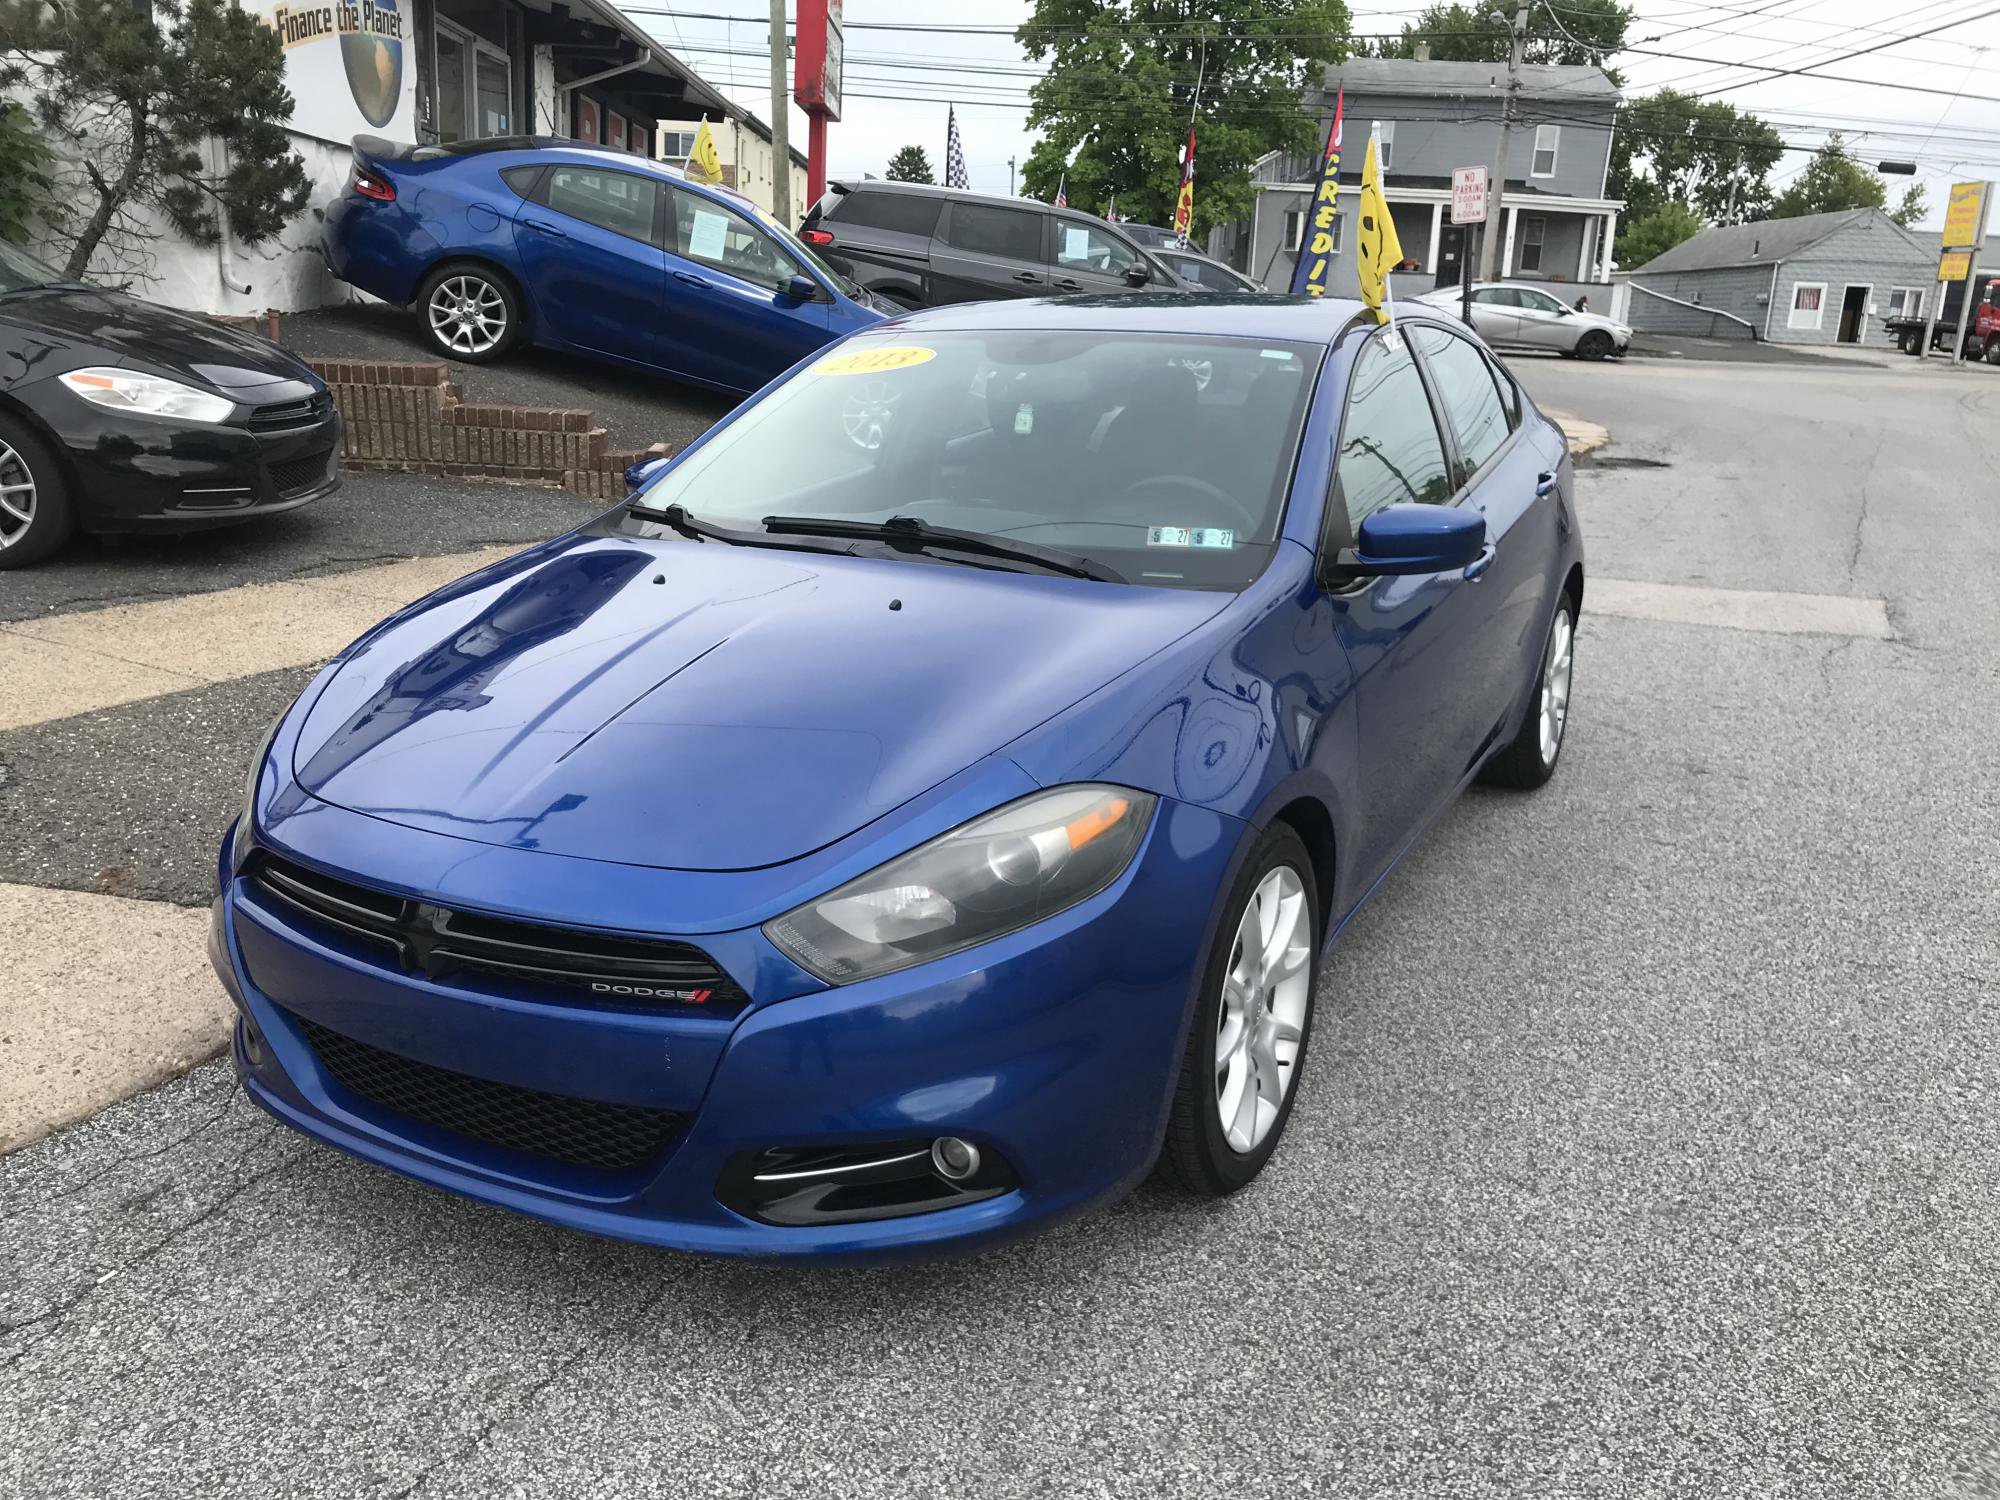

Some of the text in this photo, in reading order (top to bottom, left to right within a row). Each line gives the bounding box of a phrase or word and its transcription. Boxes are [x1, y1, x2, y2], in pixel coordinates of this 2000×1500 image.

[276, 0, 402, 46] Finance the Planet
[1464, 171, 1475, 182] NO
[1456, 183, 1484, 195] PARKING
[1306, 153, 1339, 297] CREDIT
[1178, 530, 1188, 543] 27
[1220, 532, 1231, 545] 27
[591, 983, 695, 999] DODGE
